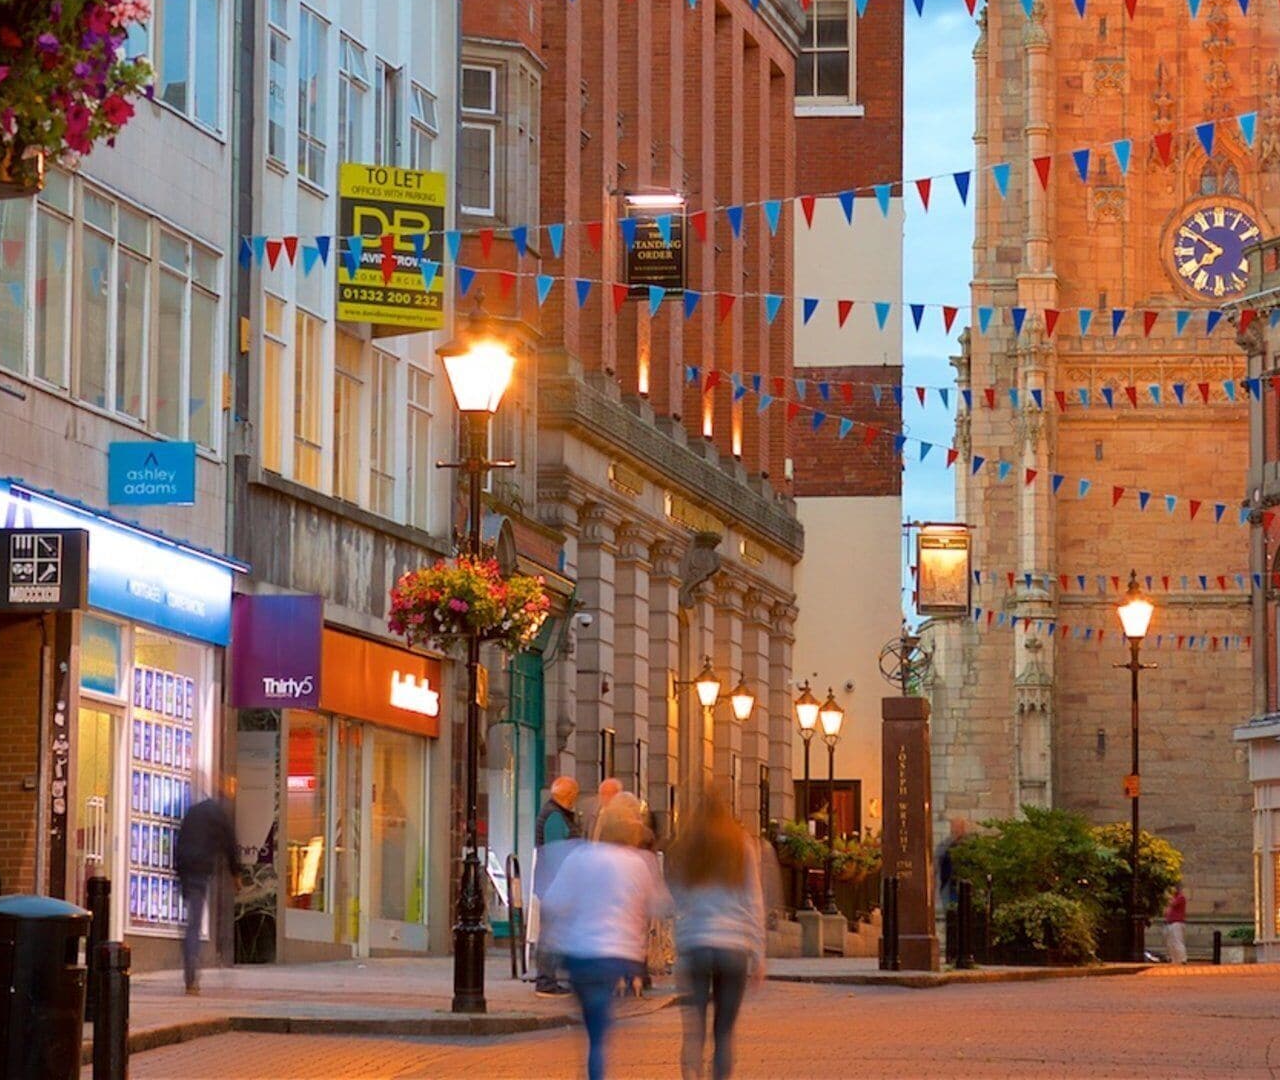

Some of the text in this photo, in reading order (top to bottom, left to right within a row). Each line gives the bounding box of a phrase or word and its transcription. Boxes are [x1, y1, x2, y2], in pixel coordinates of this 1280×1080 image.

[366, 167, 424, 189] TO LET
[351, 185, 436, 202] OFFICES WITH PARKING
[637, 250, 674, 260] ORDER
[343, 288, 439, 308] 01332 200 232
[126, 469, 177, 482] ashley
[123, 482, 177, 495] adams
[263, 675, 314, 698] Thirty5
